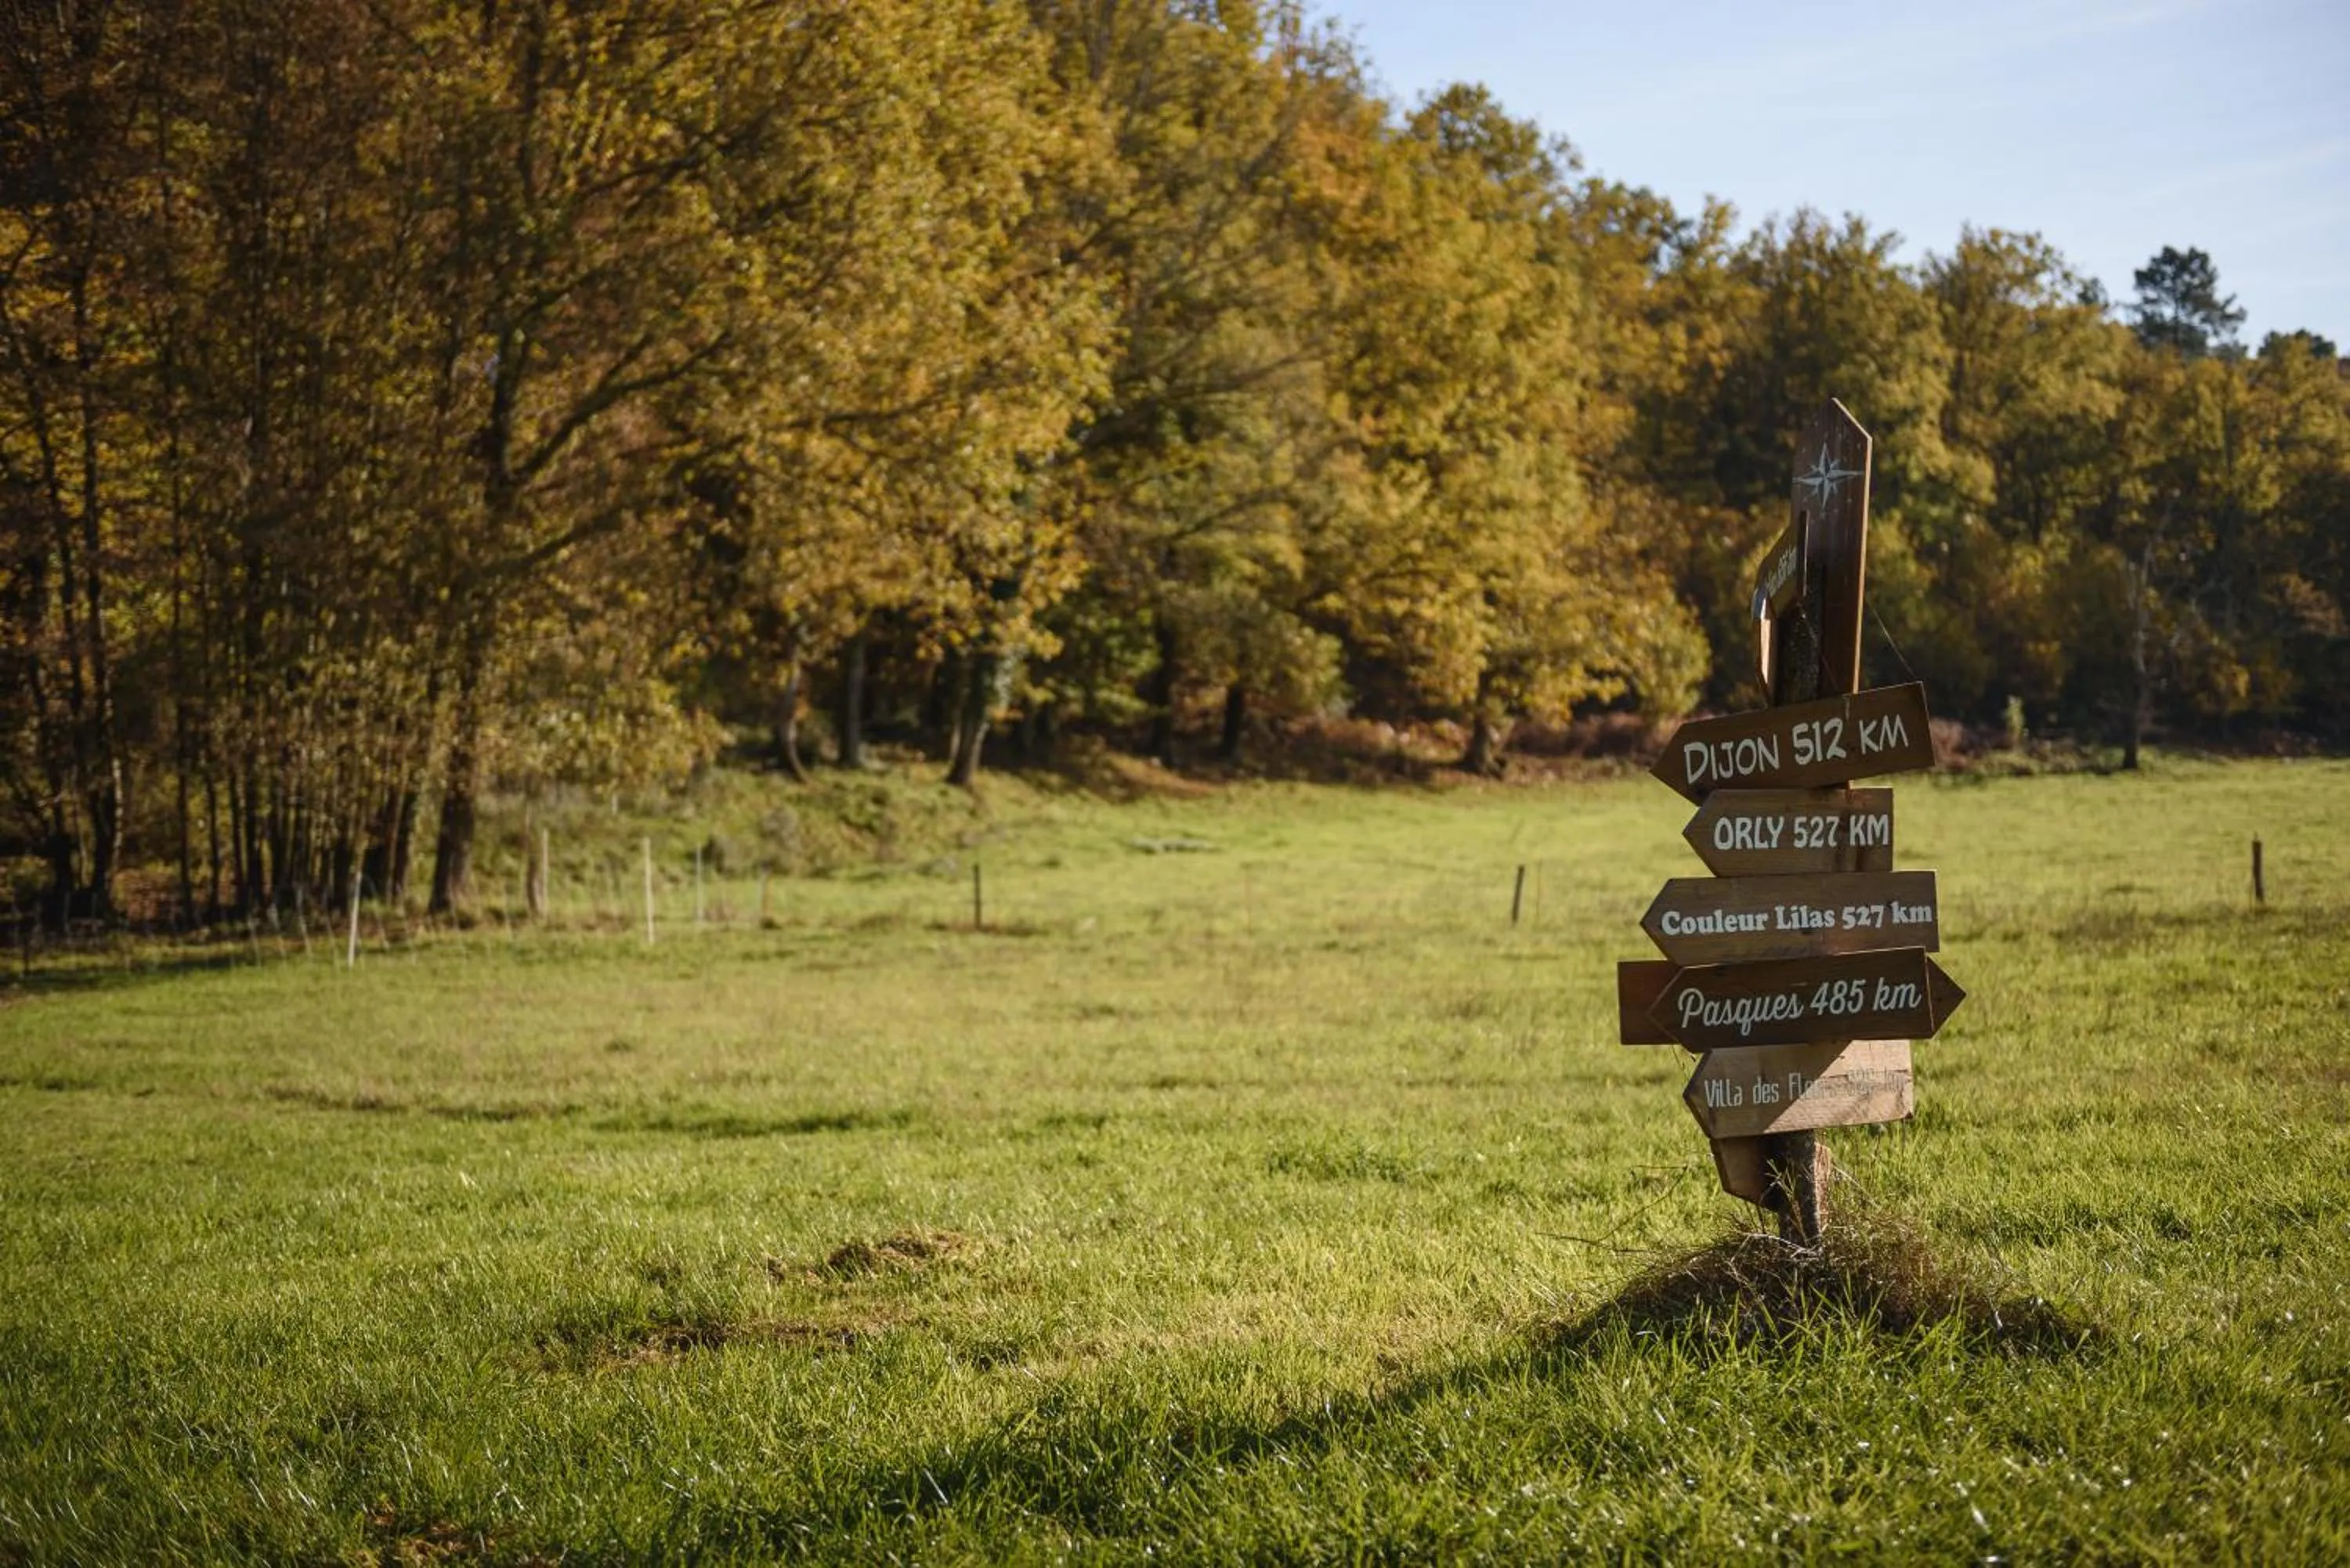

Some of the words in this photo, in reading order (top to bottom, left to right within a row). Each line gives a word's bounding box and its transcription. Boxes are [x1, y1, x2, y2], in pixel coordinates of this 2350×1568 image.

[1683, 734, 1780, 783] DIJON
[1792, 717, 1846, 766] 512
[1859, 713, 1909, 755] KM
[1714, 815, 1785, 851] ORLY
[1793, 815, 1838, 848] 527
[1849, 814, 1889, 847] KM
[1661, 908, 1769, 937] Couleur
[1774, 903, 1836, 930] Lilas
[1842, 904, 1885, 930] 527
[1890, 900, 1933, 924] km
[1677, 987, 1804, 1037] Pasques
[1810, 978, 1866, 1016] 485
[1871, 977, 1922, 1011] km
[1704, 1078, 1744, 1108] Villa
[1752, 1075, 1780, 1104] des
